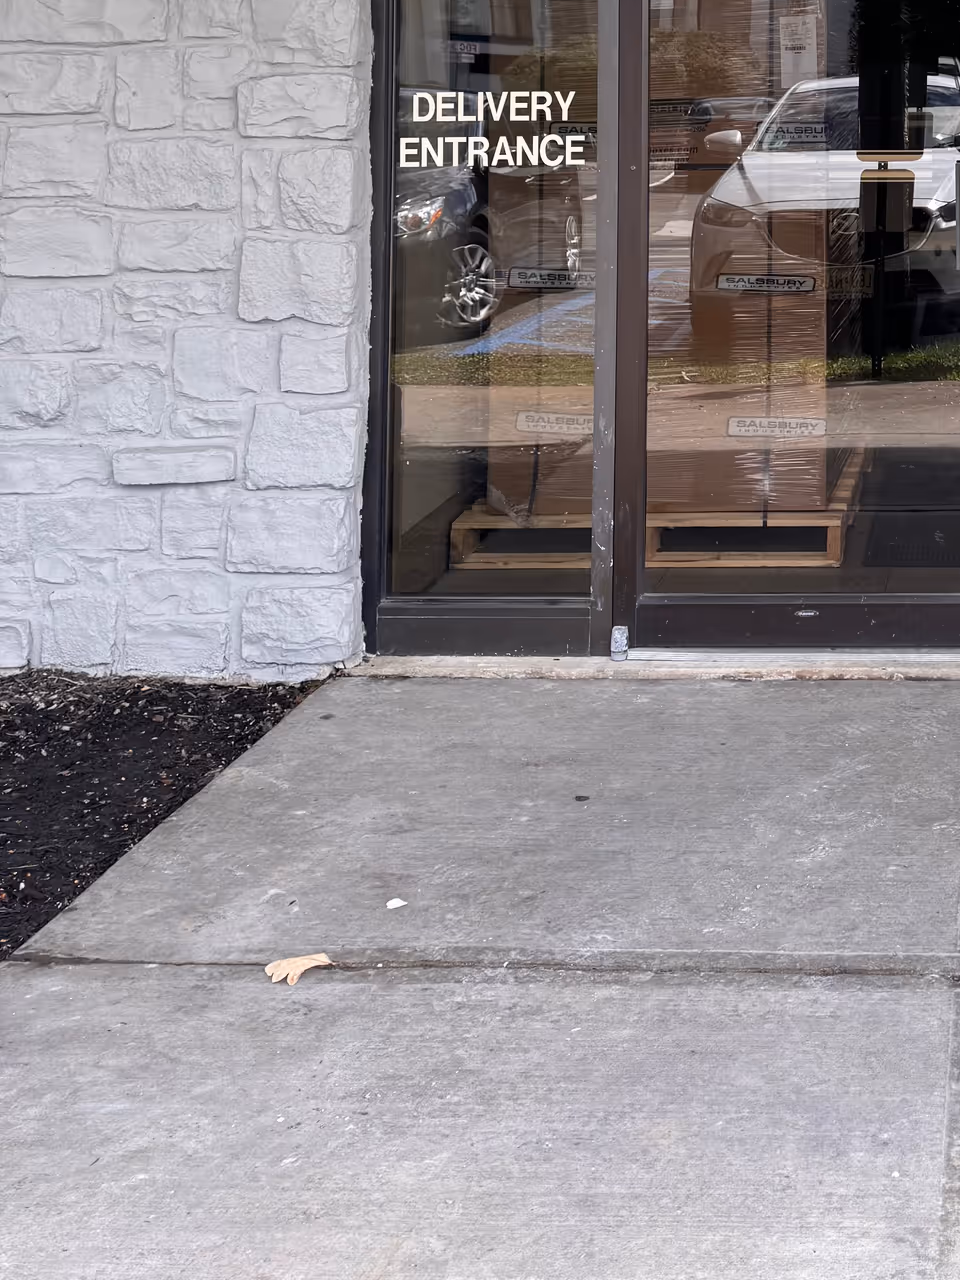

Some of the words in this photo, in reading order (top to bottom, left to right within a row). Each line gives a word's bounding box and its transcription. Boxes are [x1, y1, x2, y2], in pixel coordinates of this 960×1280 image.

[412, 91, 576, 122] DELIVERY
[399, 133, 586, 168] ENTRANCE
[517, 271, 596, 282] SALSBURY
[725, 277, 807, 287] SALSBURY
[736, 419, 819, 431] SALSBURY
